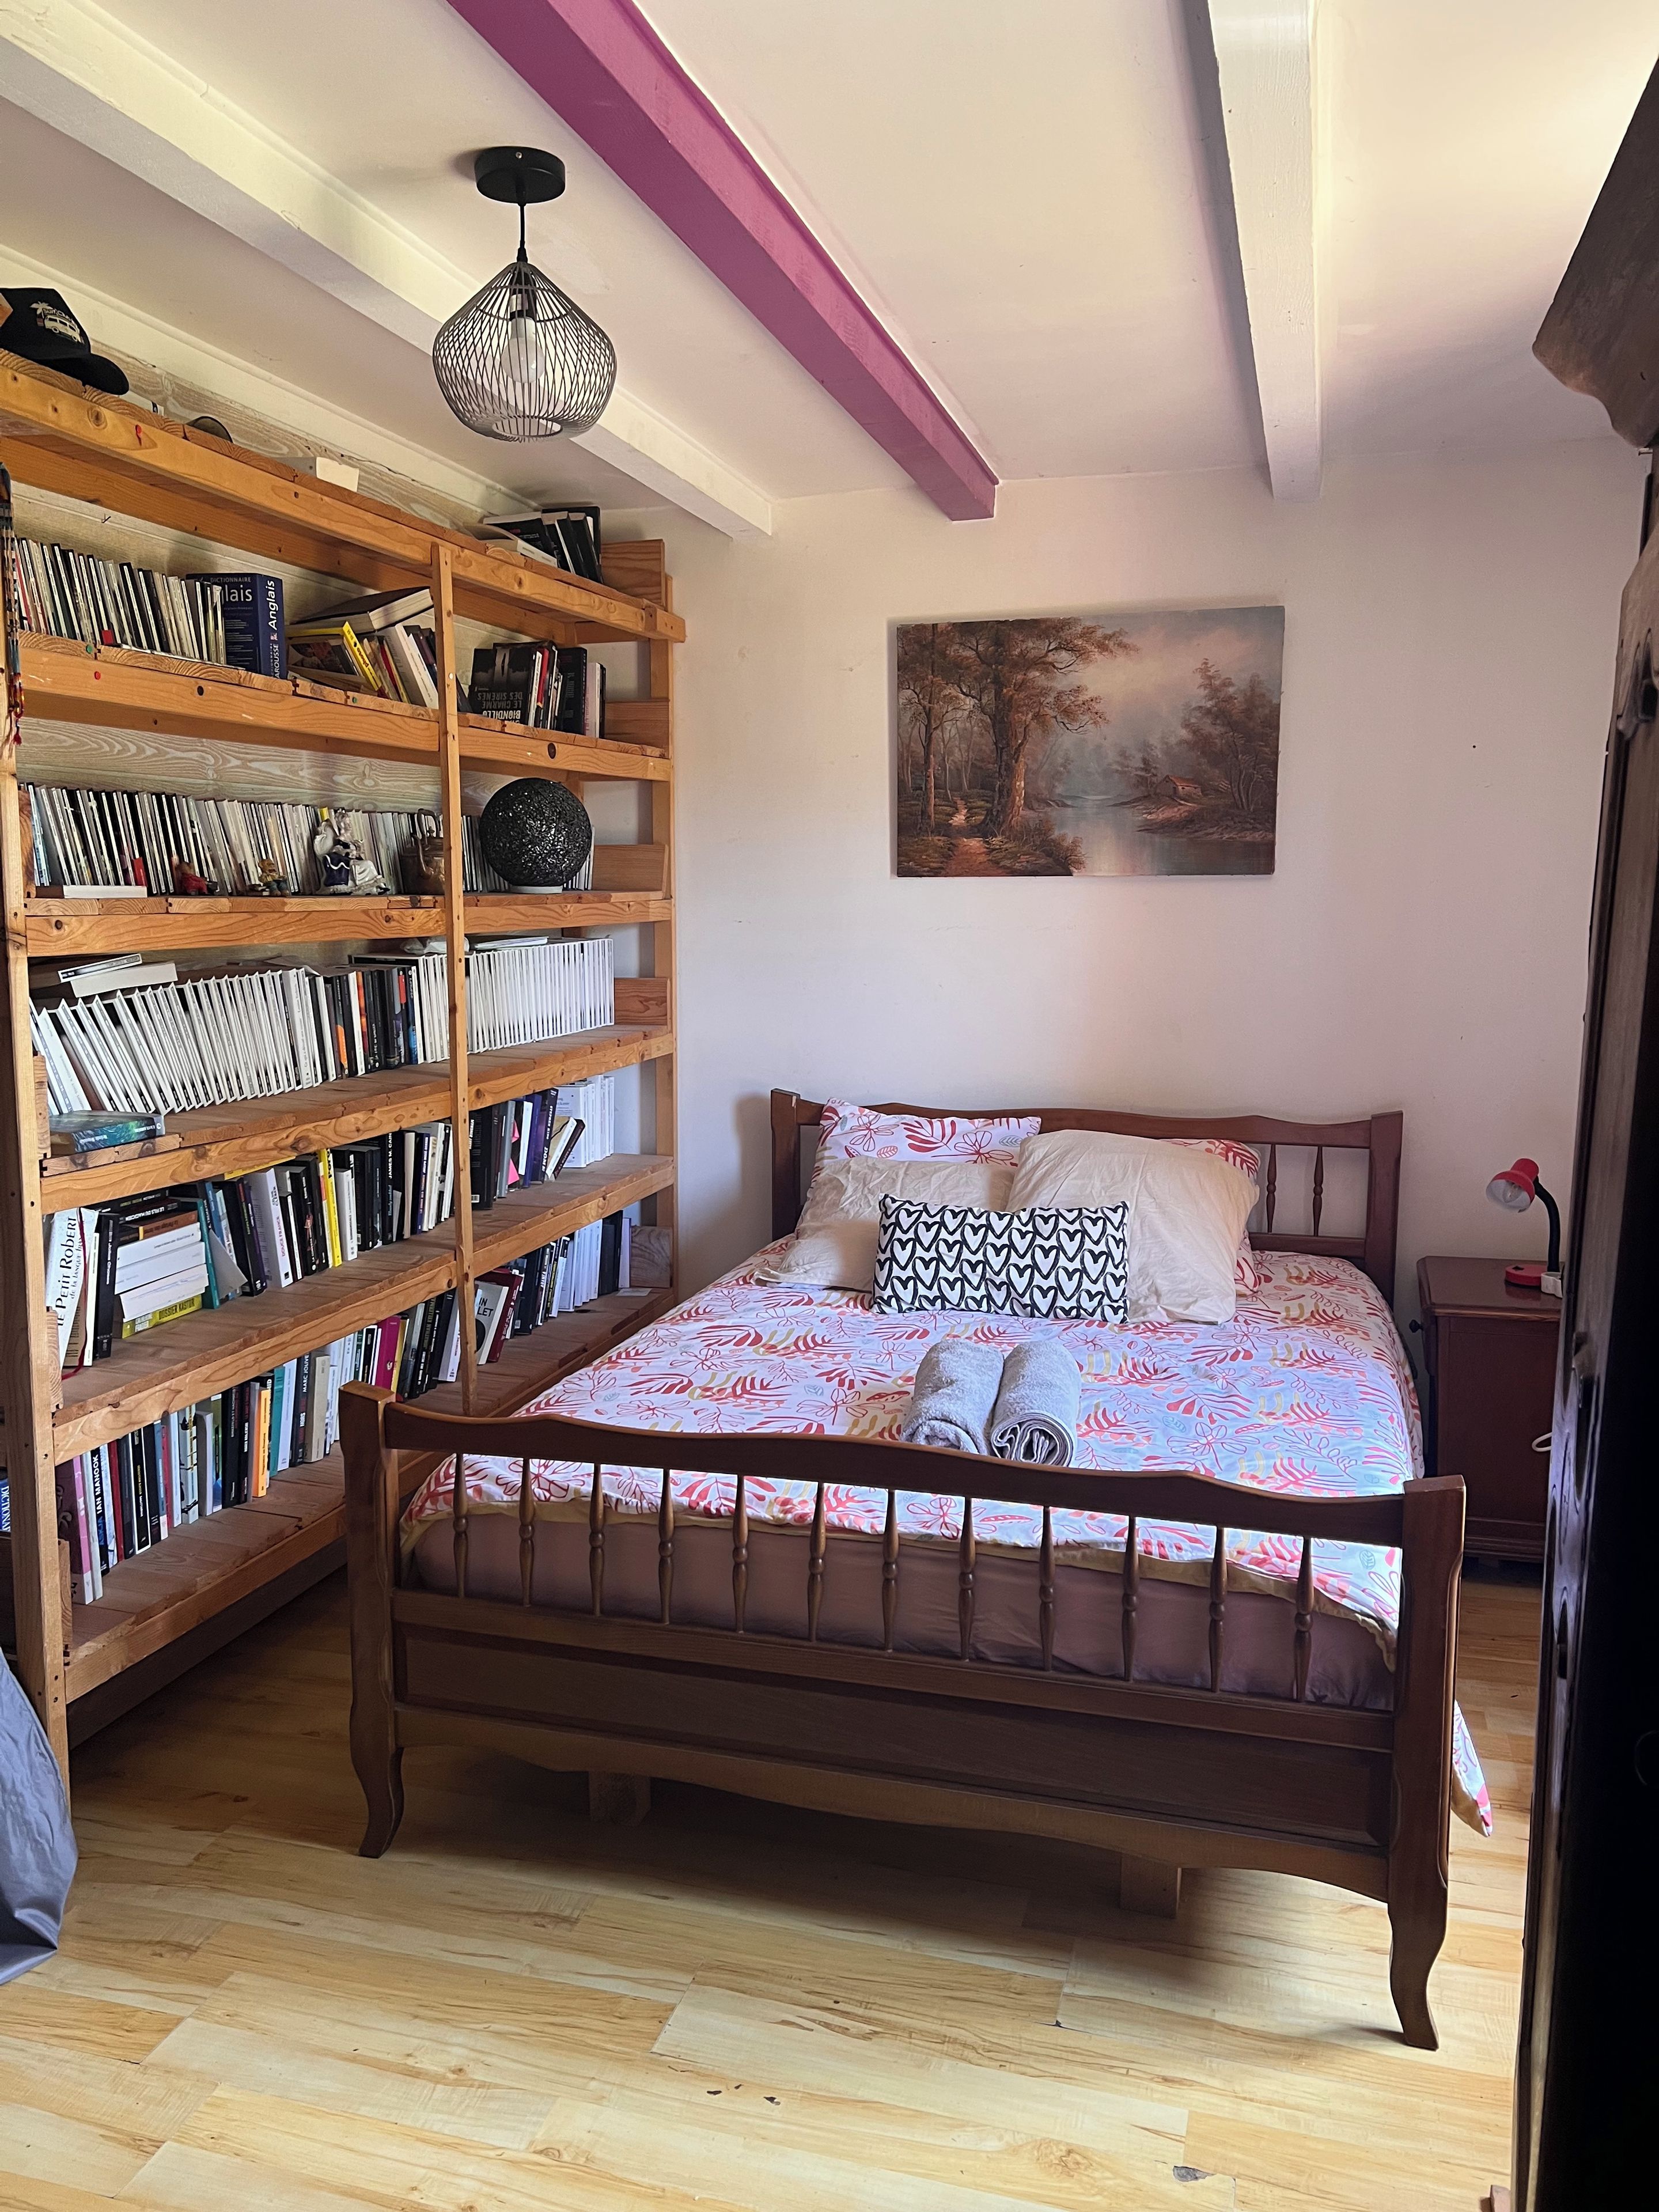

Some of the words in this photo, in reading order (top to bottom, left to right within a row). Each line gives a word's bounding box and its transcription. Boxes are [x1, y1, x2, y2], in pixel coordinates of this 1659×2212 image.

[222, 584, 252, 604] lais
[266, 580, 279, 630] Anglais
[482, 700, 511, 709] CHARME
[93, 1454, 101, 1496] MANOOK
